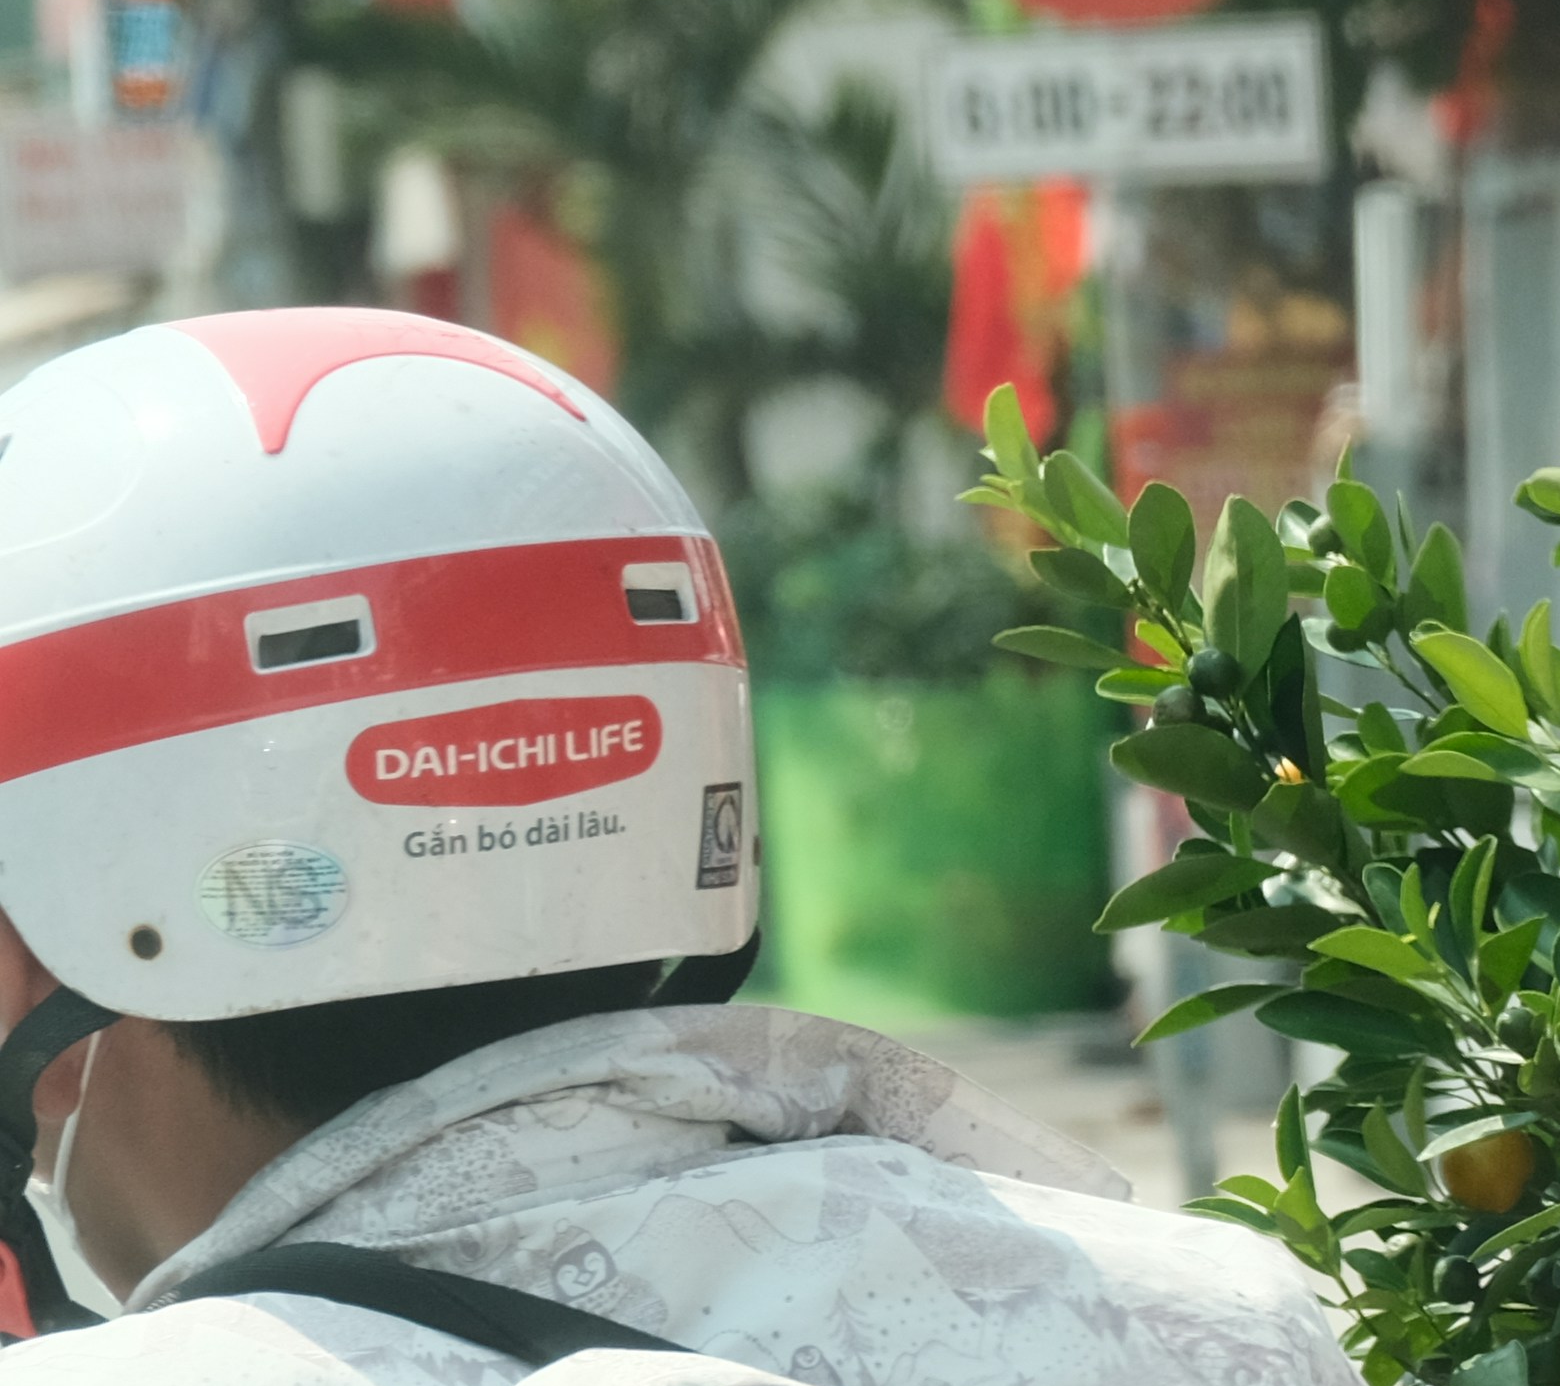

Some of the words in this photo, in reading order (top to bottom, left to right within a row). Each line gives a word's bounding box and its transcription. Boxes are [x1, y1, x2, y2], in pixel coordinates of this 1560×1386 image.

[375, 733, 557, 780] DAI-ICHI
[565, 719, 643, 761] LIFE
[404, 823, 467, 858] Gắn
[477, 821, 516, 852] bó
[525, 817, 570, 846] dài
[578, 811, 626, 839] lâu.
